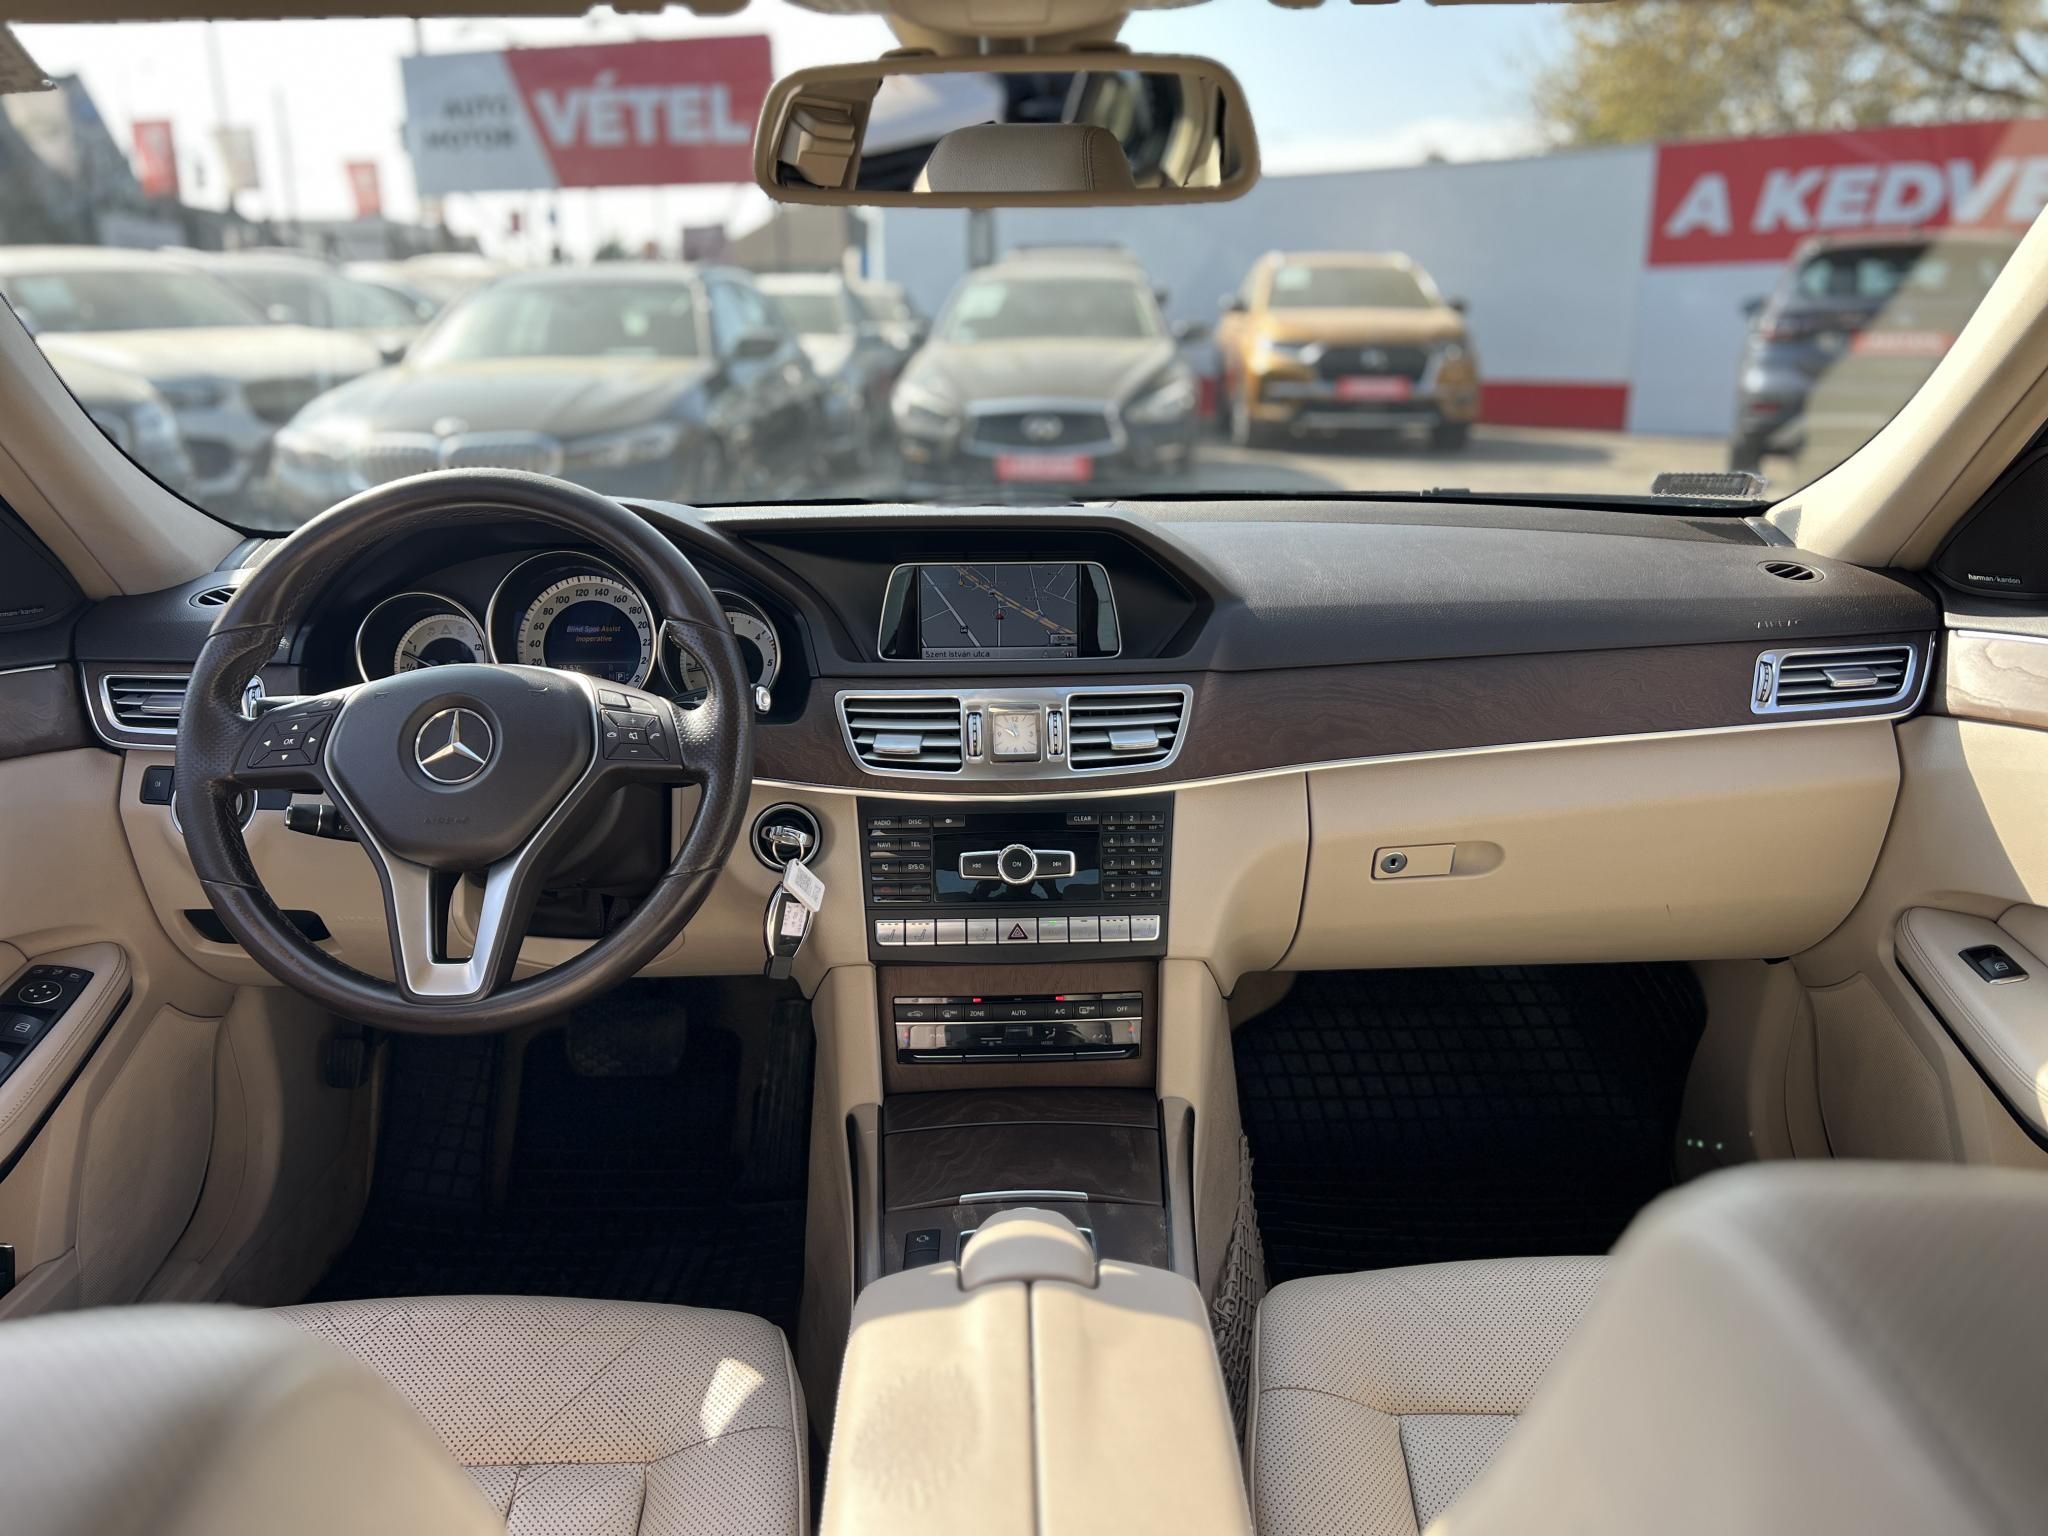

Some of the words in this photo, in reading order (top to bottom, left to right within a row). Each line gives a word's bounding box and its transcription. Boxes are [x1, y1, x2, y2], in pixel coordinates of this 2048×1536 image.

[442, 95, 508, 119] AUTO
[535, 69, 750, 146] VÉTEL
[425, 127, 515, 148] MOTOR
[1664, 171, 1732, 238] A
[575, 588, 589, 597] 120
[594, 588, 609, 597] 140
[555, 595, 570, 604] 100
[613, 594, 628, 603] 160
[542, 607, 554, 616] 80
[628, 605, 642, 615] 180
[533, 622, 545, 631] 60
[529, 639, 541, 648] 40
[925, 650, 947, 658] Szent
[531, 658, 542, 666] 20
[767, 659, 774, 667] 5
